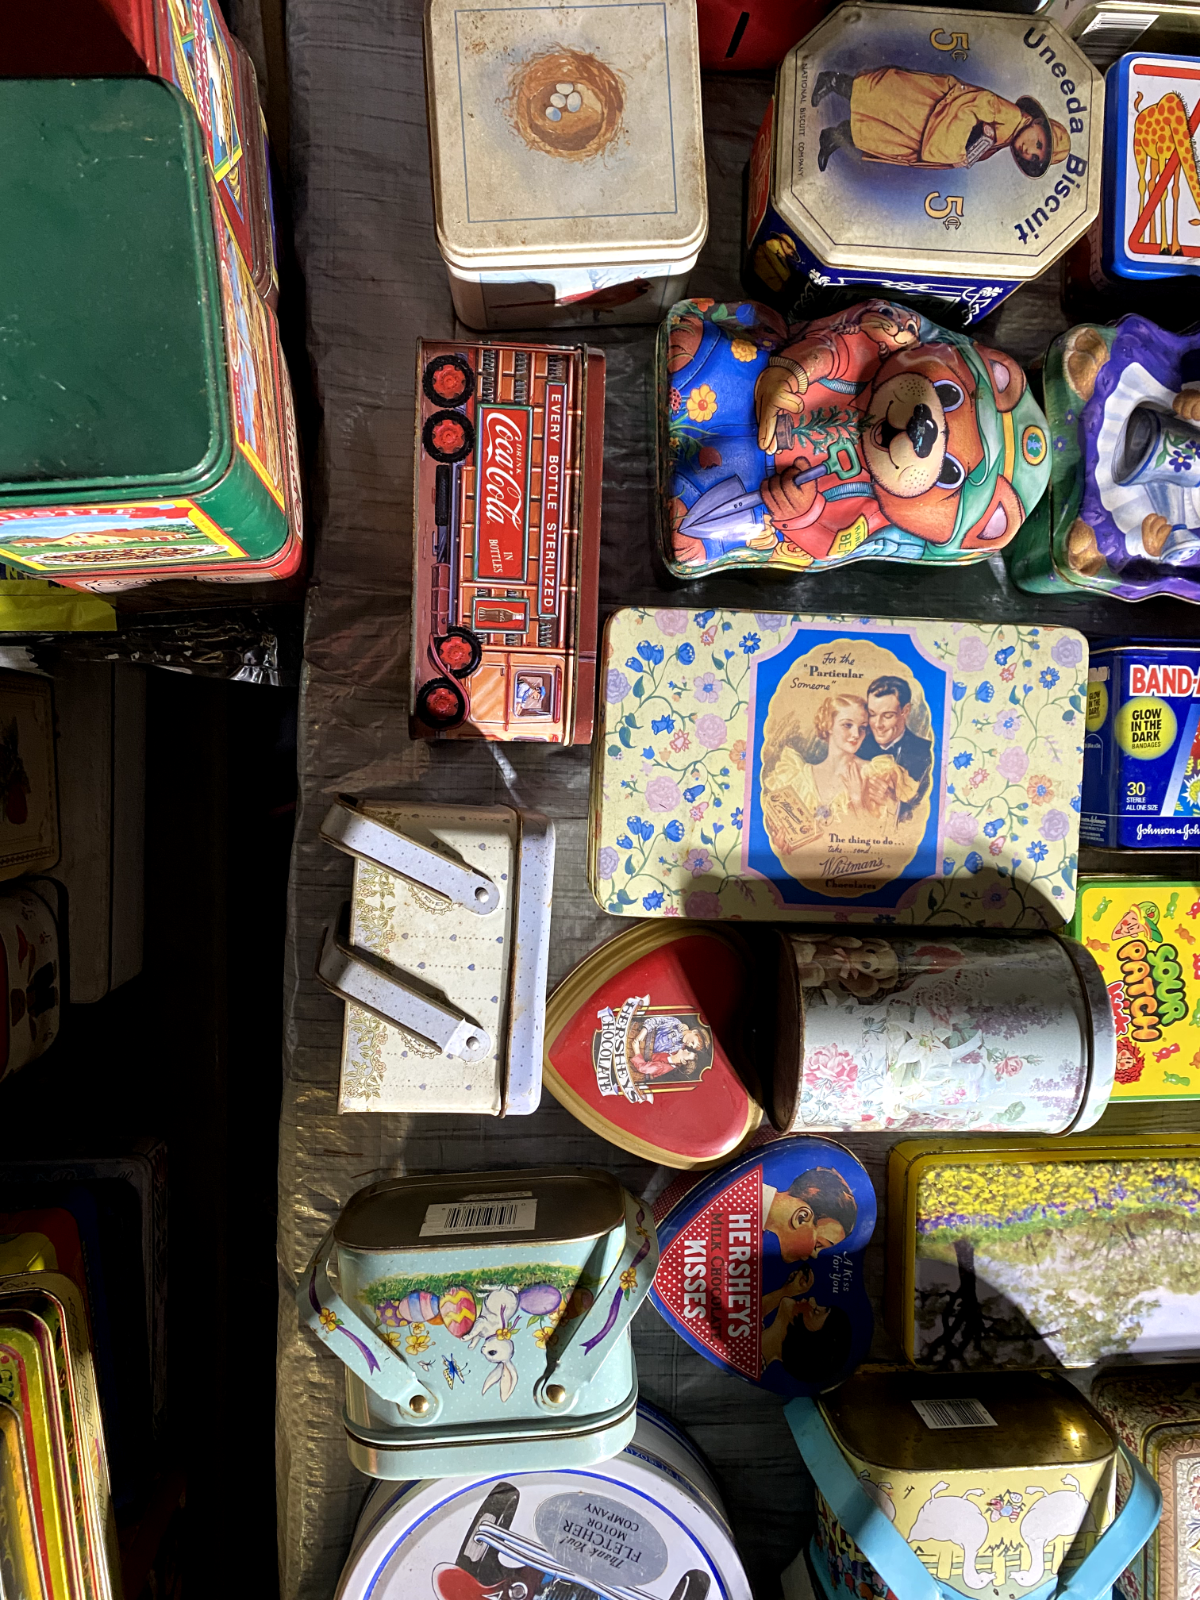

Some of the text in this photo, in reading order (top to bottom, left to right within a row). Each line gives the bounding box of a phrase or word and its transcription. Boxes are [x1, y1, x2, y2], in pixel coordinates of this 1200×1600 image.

[800, 62, 808, 104] NATIONAL
[1014, 26, 1088, 246] Uneeda Biscuit
[797, 142, 806, 178] COMPANY
[515, 442, 523, 475] DRINK
[543, 393, 562, 608] EVERY BOTTLE STERILIZED
[488, 538, 503, 574] BOTTLES
[503, 551, 514, 561] IN
[822, 651, 856, 666] For the
[1131, 720, 1162, 732] IN THE
[1132, 708, 1163, 721] GLOW
[1131, 741, 1162, 750] BANDAGES
[1132, 731, 1161, 743] DARK
[1126, 781, 1146, 796] 30
[1147, 804, 1158, 812] SIZE
[829, 832, 846, 844] The
[848, 835, 871, 846] thing
[1136, 823, 1176, 841] Johnson
[819, 855, 886, 878] Whitman's
[825, 878, 877, 890] Chocolates
[1116, 940, 1163, 1042] PATCH
[1146, 943, 1189, 1027] SOUR
[598, 1014, 614, 1093] CHOCOLATE
[683, 1239, 707, 1320] KISSES
[710, 1211, 726, 1341] MILK CHOCOLATE
[828, 1254, 843, 1294] for You
[842, 1250, 853, 1293] A Kiss
[583, 1502, 640, 1532] COMPANY
[586, 1517, 628, 1541] MOTOR
[558, 1536, 625, 1570] Thank You!
[562, 1518, 643, 1563] FLETCHER
